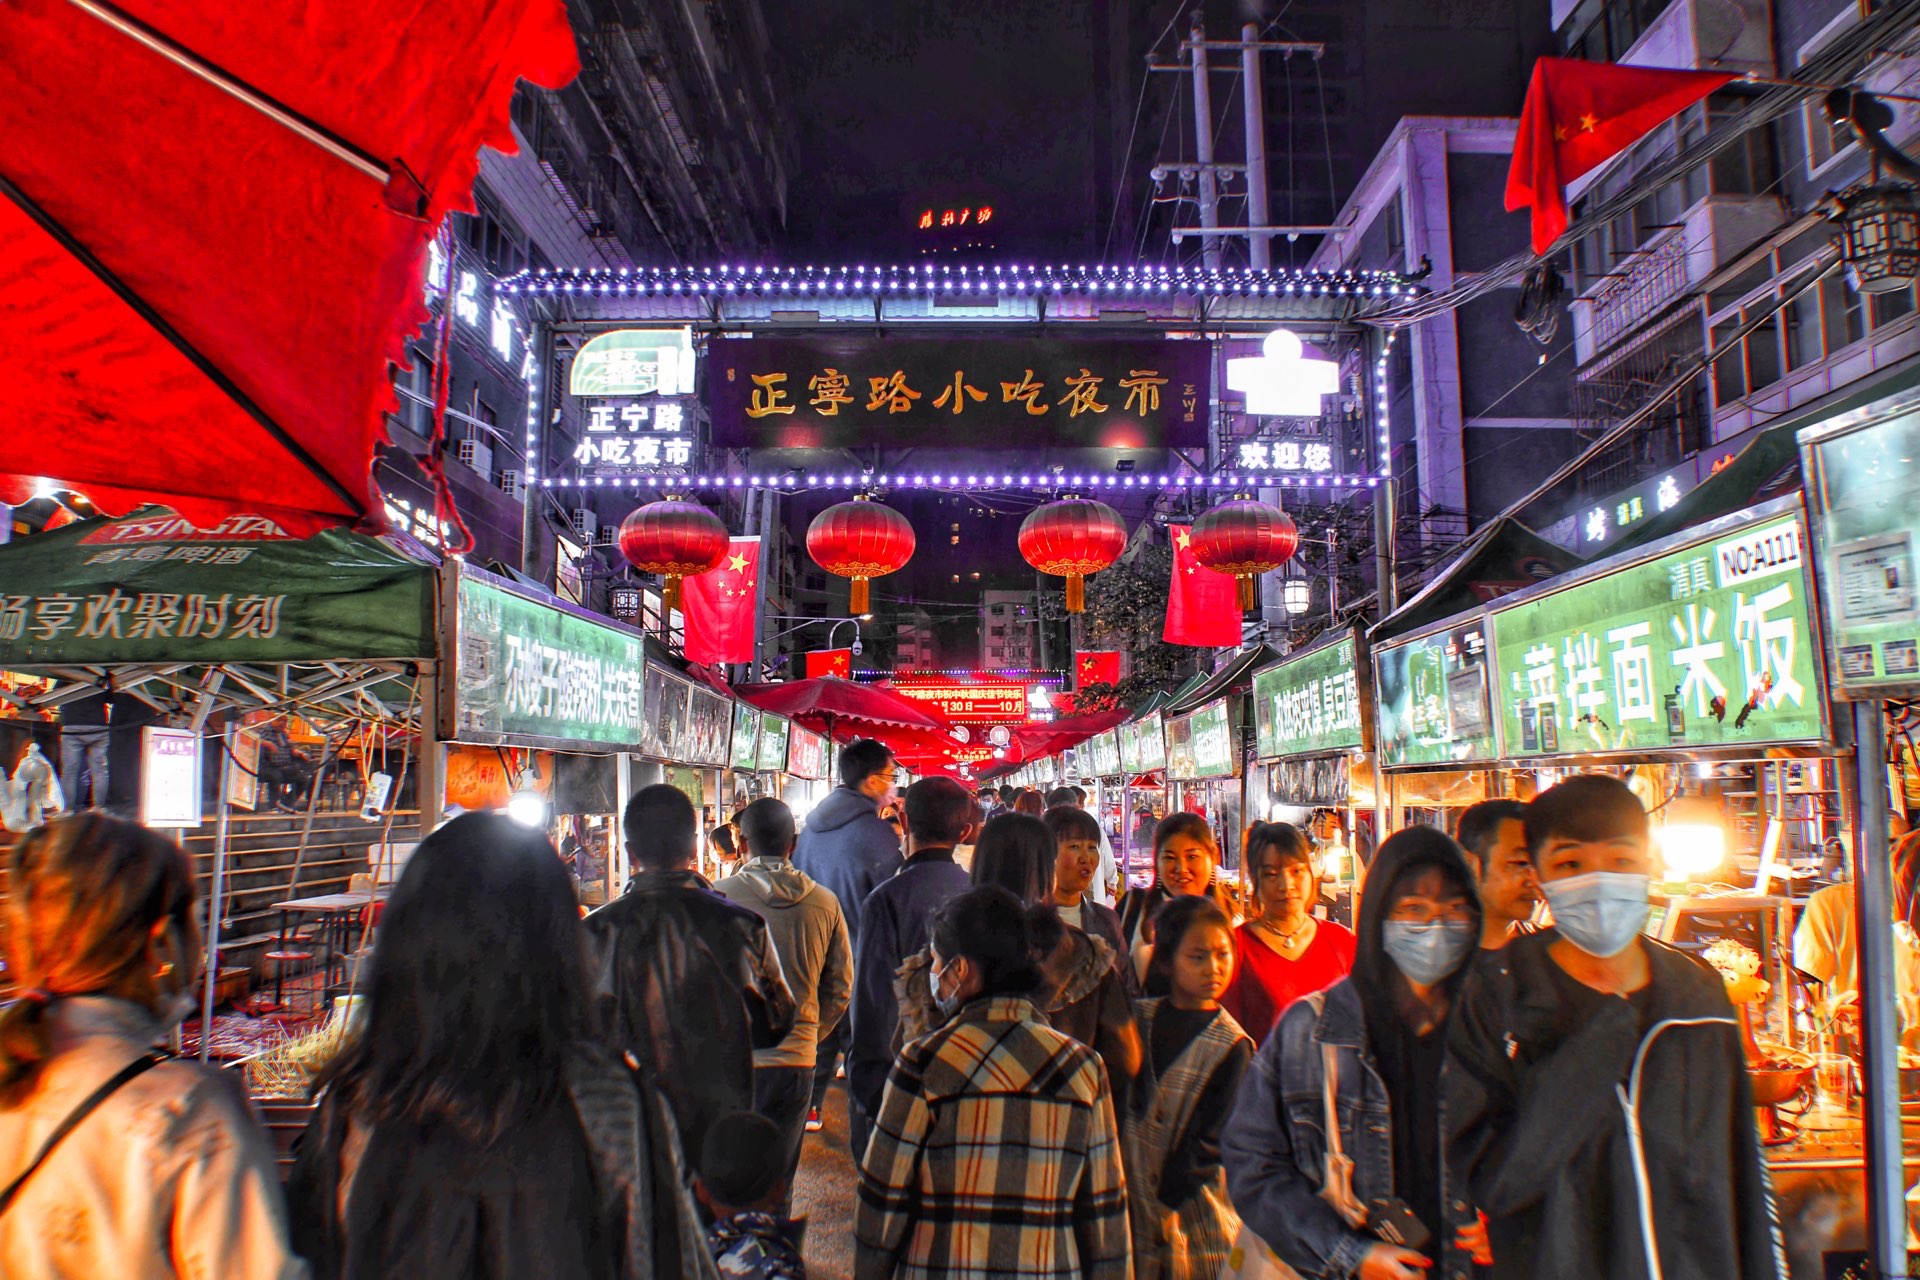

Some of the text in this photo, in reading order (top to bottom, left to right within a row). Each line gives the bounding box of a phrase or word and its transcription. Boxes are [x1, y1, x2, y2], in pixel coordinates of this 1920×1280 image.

[587, 404, 684, 432] 正宁路
[573, 437, 692, 465] 小吃夜市
[1240, 442, 1332, 471] 欢迎您
[1668, 556, 1713, 600] 清真
